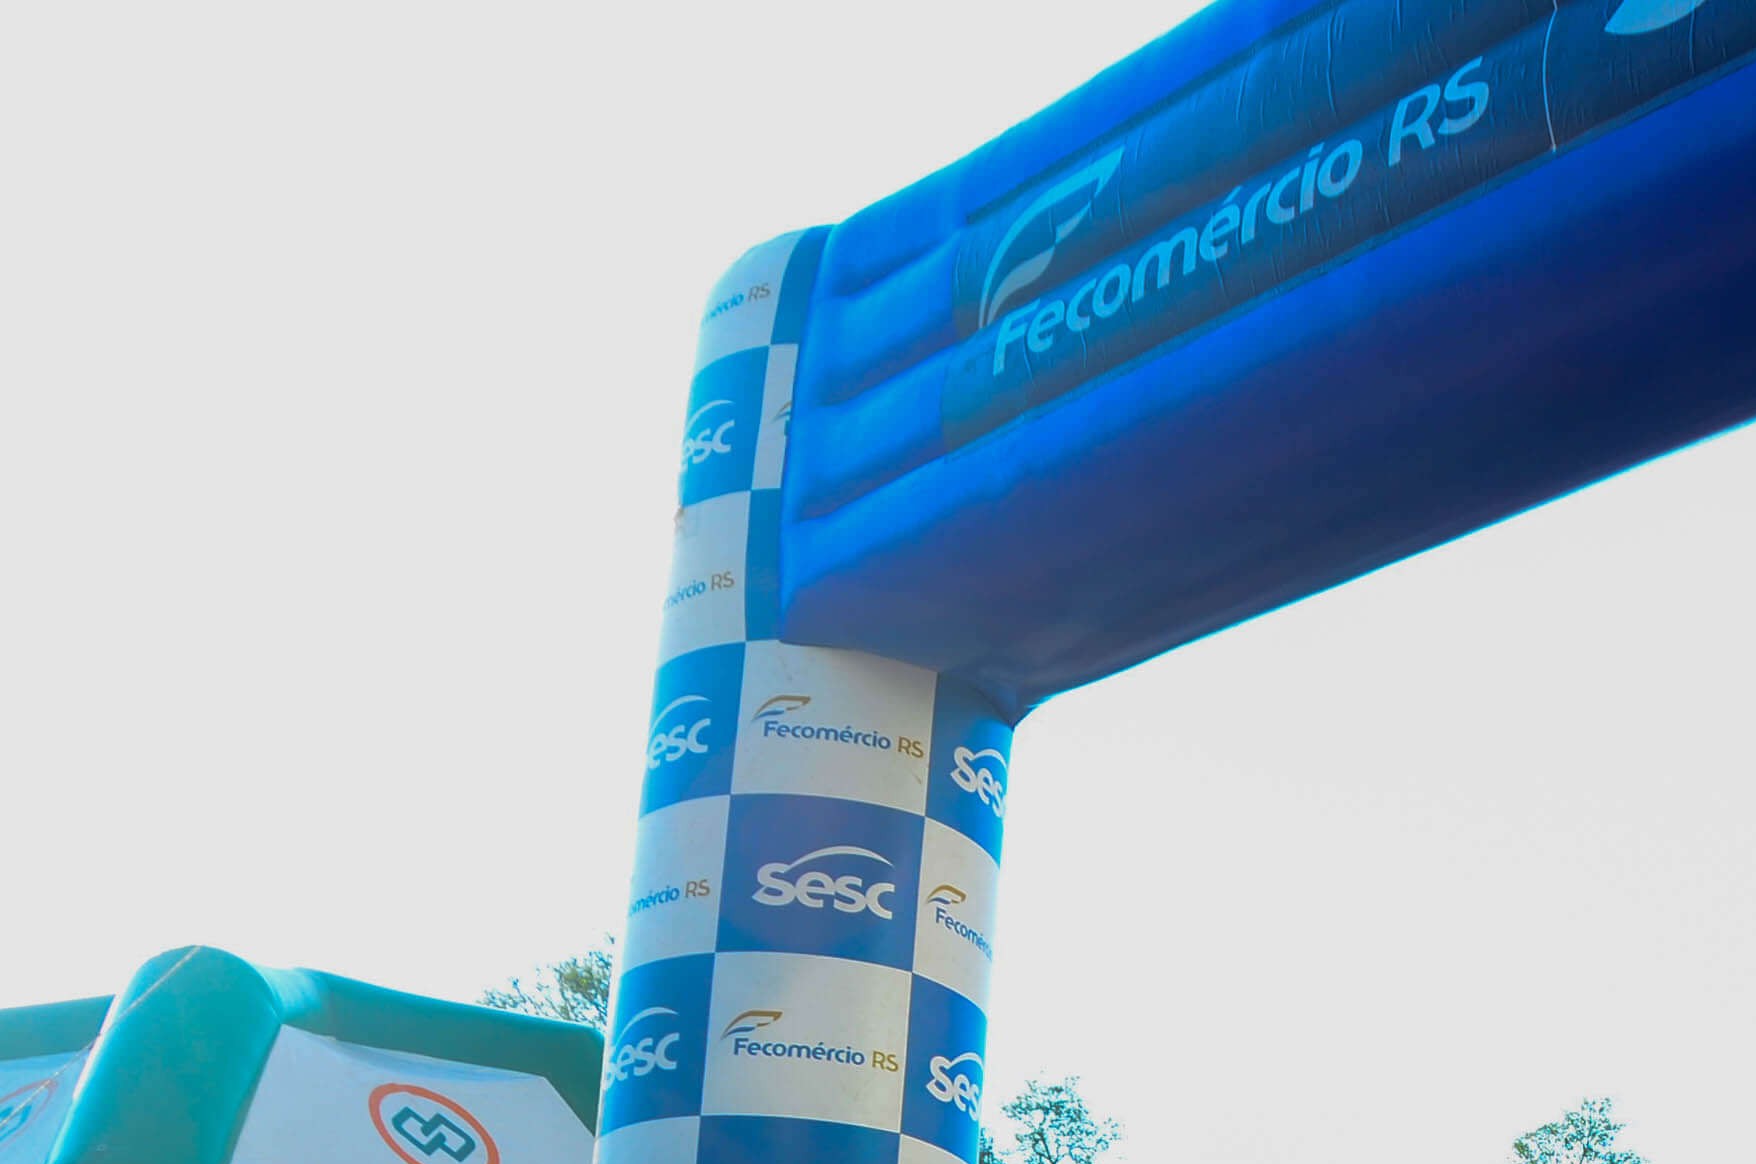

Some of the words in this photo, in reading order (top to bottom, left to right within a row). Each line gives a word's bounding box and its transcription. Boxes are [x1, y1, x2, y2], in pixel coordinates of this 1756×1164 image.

[991, 141, 1363, 376] Fecomércio
[1388, 57, 1491, 168] RS
[748, 283, 771, 302] RS
[711, 571, 735, 593] RS
[762, 719, 892, 751] Fecomércio
[897, 737, 925, 759] RS
[685, 880, 711, 899] RS
[732, 1037, 866, 1066] Fecomércio
[871, 1050, 899, 1073] RS
